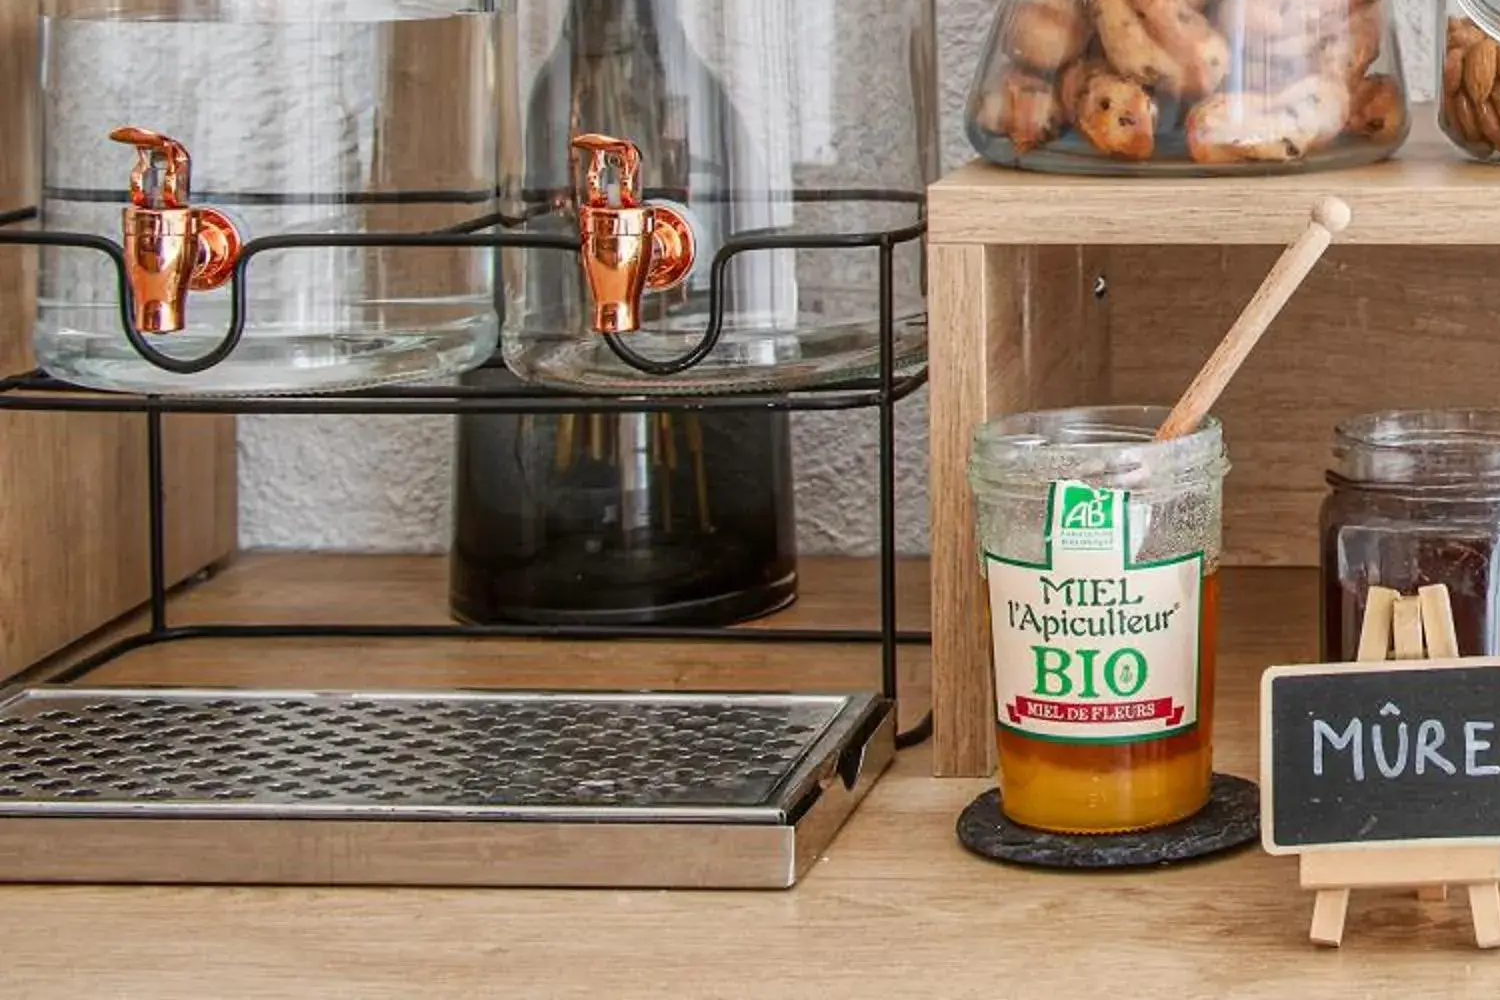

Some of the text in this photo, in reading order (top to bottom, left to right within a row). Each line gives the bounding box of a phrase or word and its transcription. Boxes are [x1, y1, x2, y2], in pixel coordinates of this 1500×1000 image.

[1064, 500, 1105, 528] AB
[1039, 576, 1144, 607] MIEL
[1008, 600, 1175, 642] l'Apiculteur
[1030, 645, 1149, 698] BIO
[1027, 702, 1156, 721] MIEL DE FLEURS
